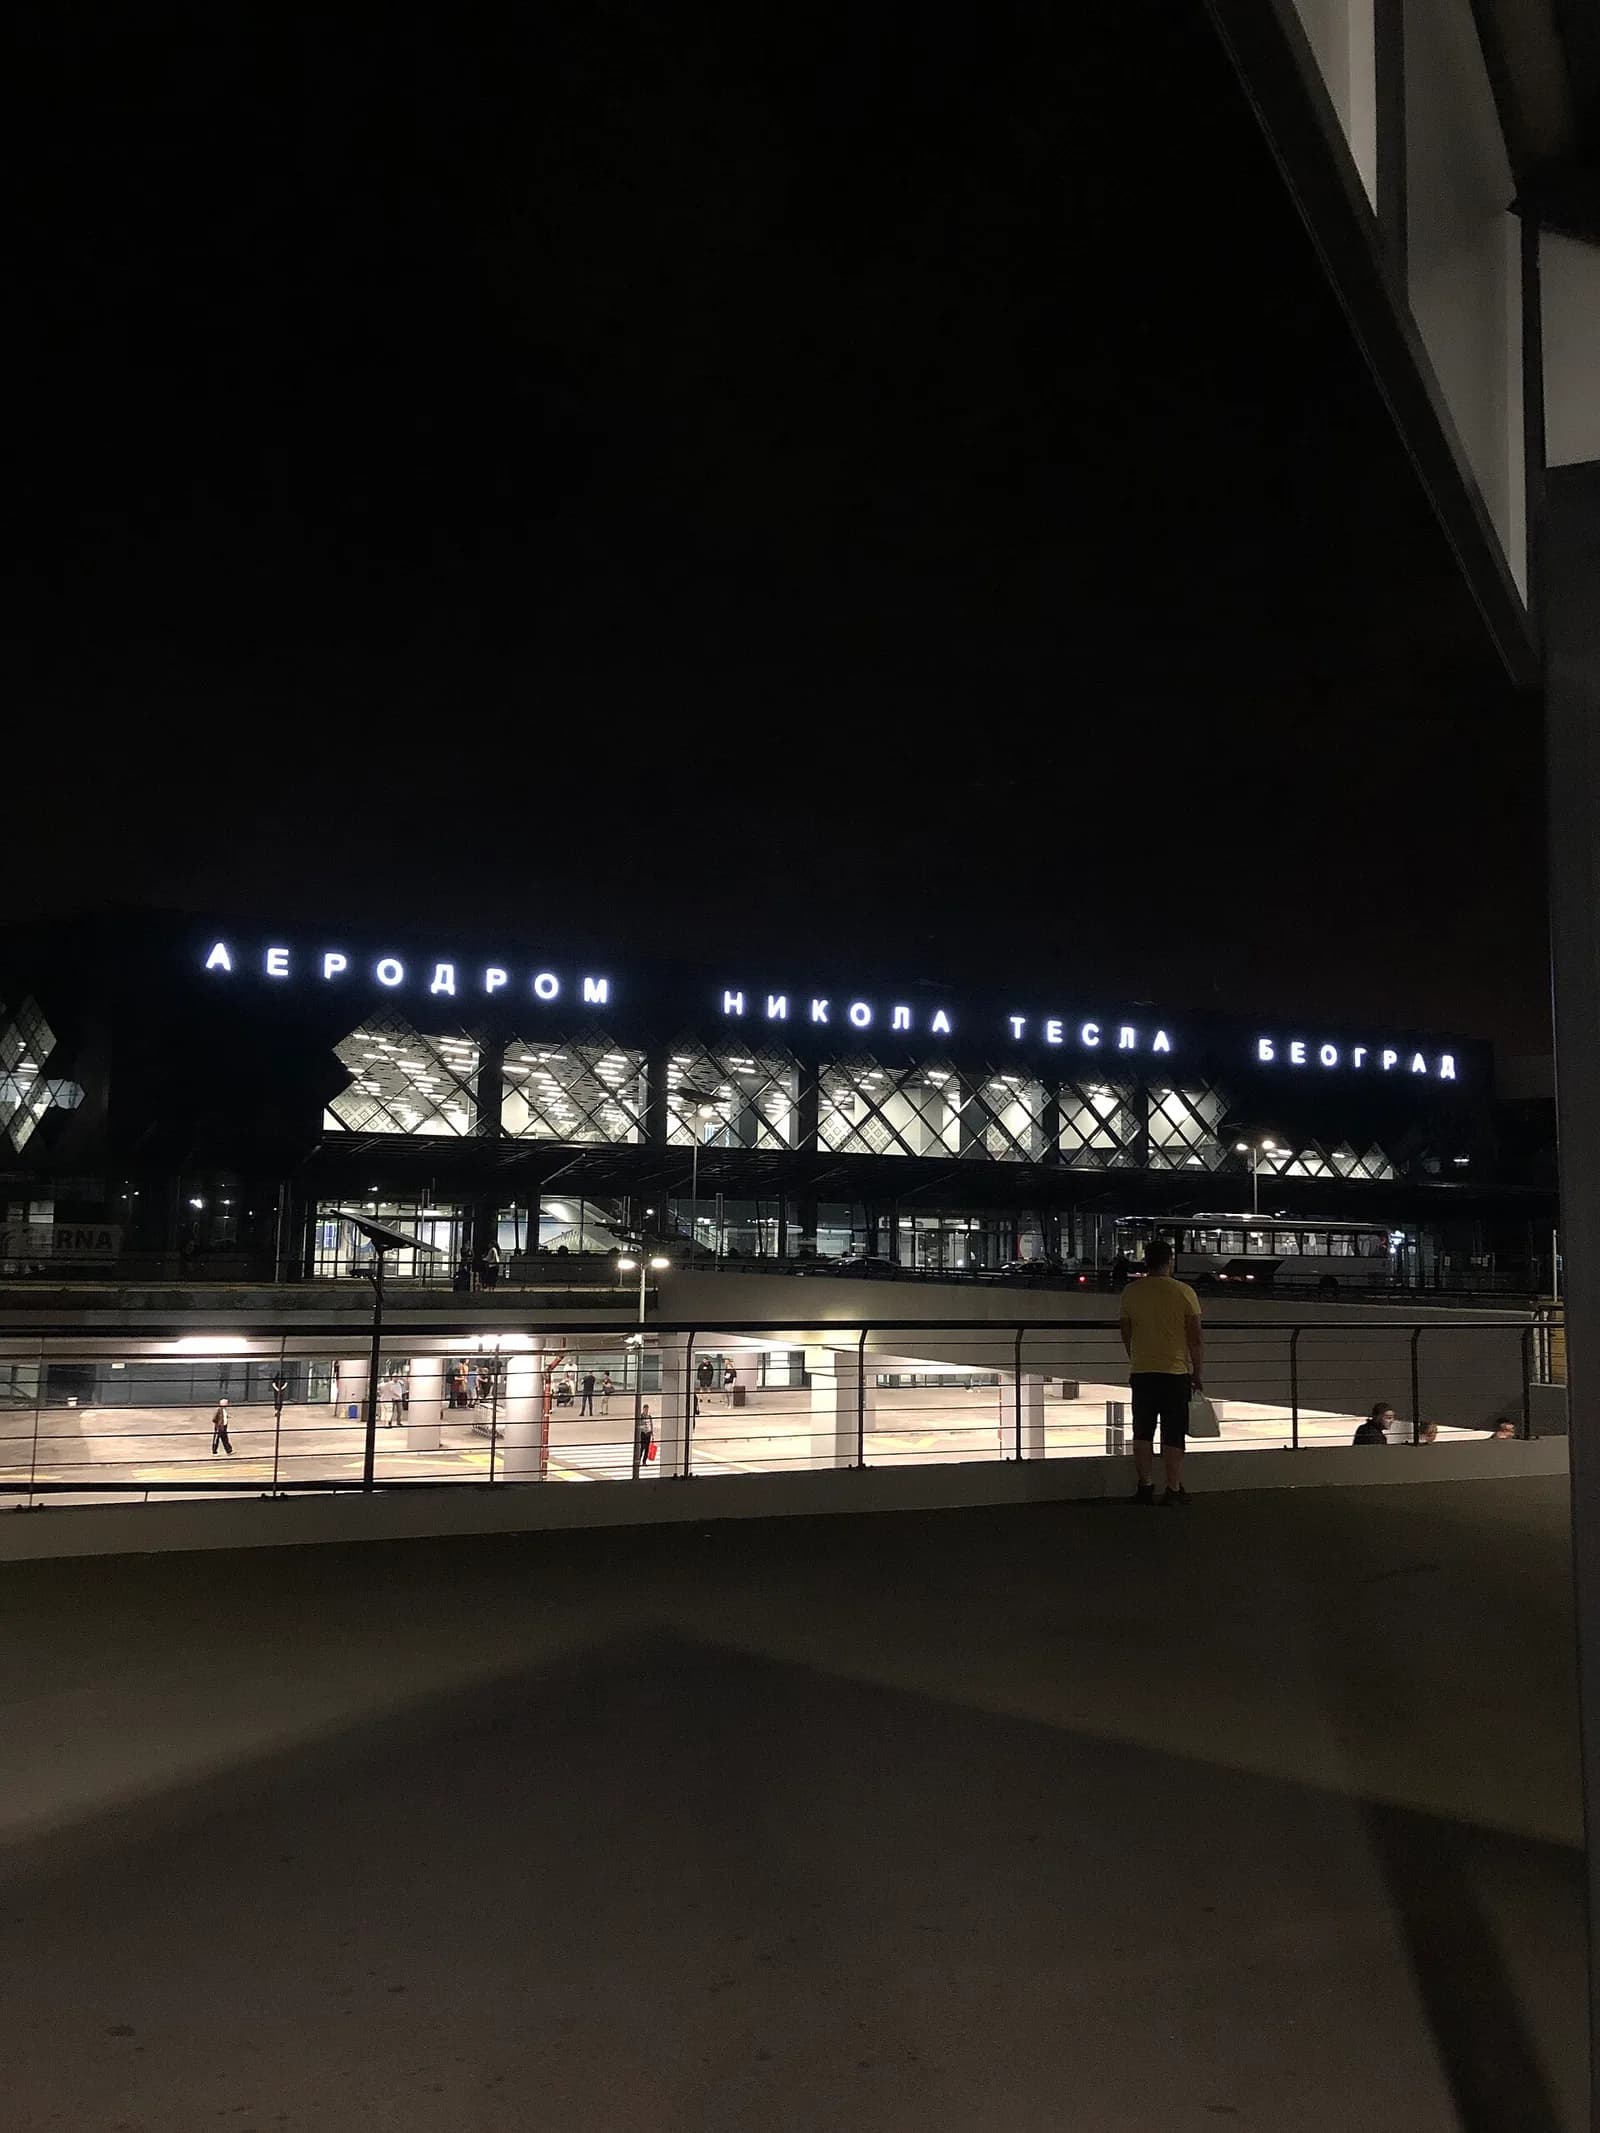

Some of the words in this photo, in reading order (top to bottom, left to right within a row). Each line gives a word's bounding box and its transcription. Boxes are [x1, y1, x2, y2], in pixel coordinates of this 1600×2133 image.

[204, 941, 611, 1005] АЕРОДРОМ
[722, 989, 953, 1035] НИКОЛА
[1008, 1015, 1172, 1054] ТЕСЛА
[1257, 1037, 1457, 1081] БЕОГРАД
